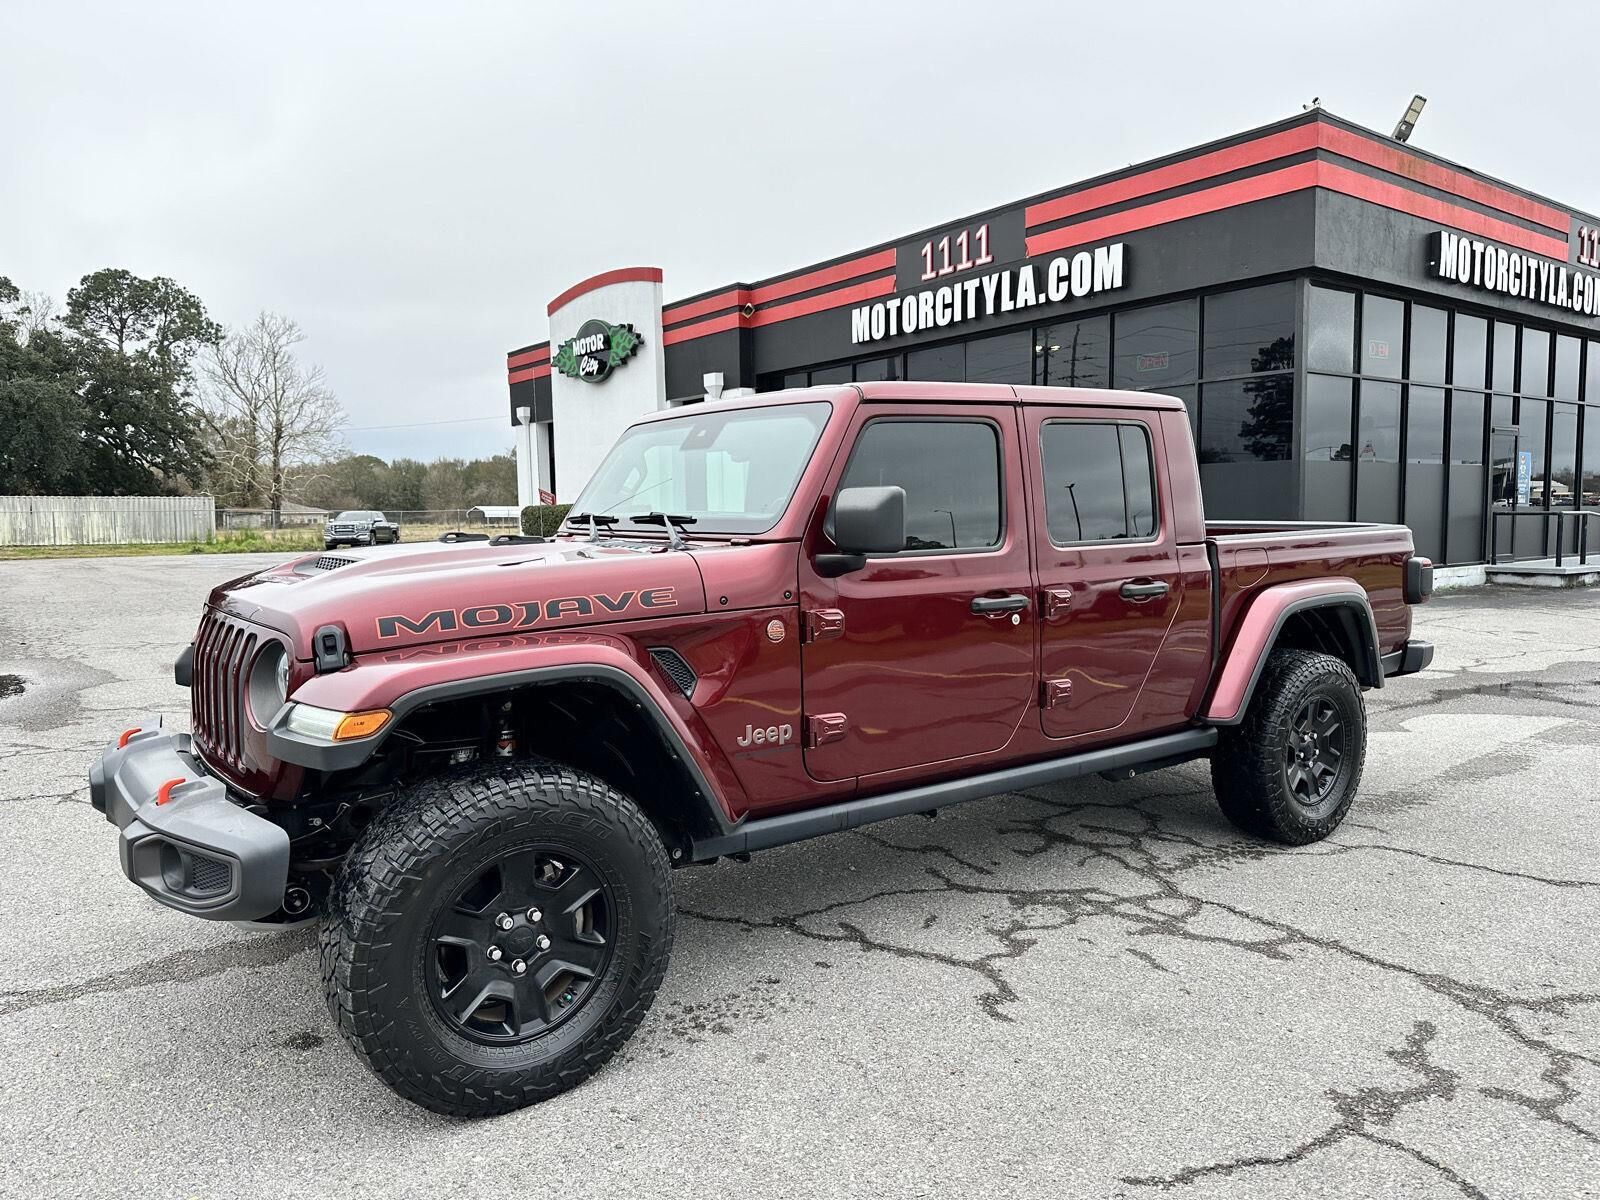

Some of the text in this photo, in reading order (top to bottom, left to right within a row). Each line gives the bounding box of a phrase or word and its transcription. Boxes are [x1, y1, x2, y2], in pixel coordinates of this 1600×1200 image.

[920, 224, 994, 281] 1111
[1577, 226, 1600, 268] 11
[851, 242, 1124, 344] MOTORCITYLA.COM
[572, 333, 604, 357] MOTOR
[580, 355, 599, 376] City
[375, 586, 678, 639] MOJAVE
[736, 724, 793, 747] Jeep
